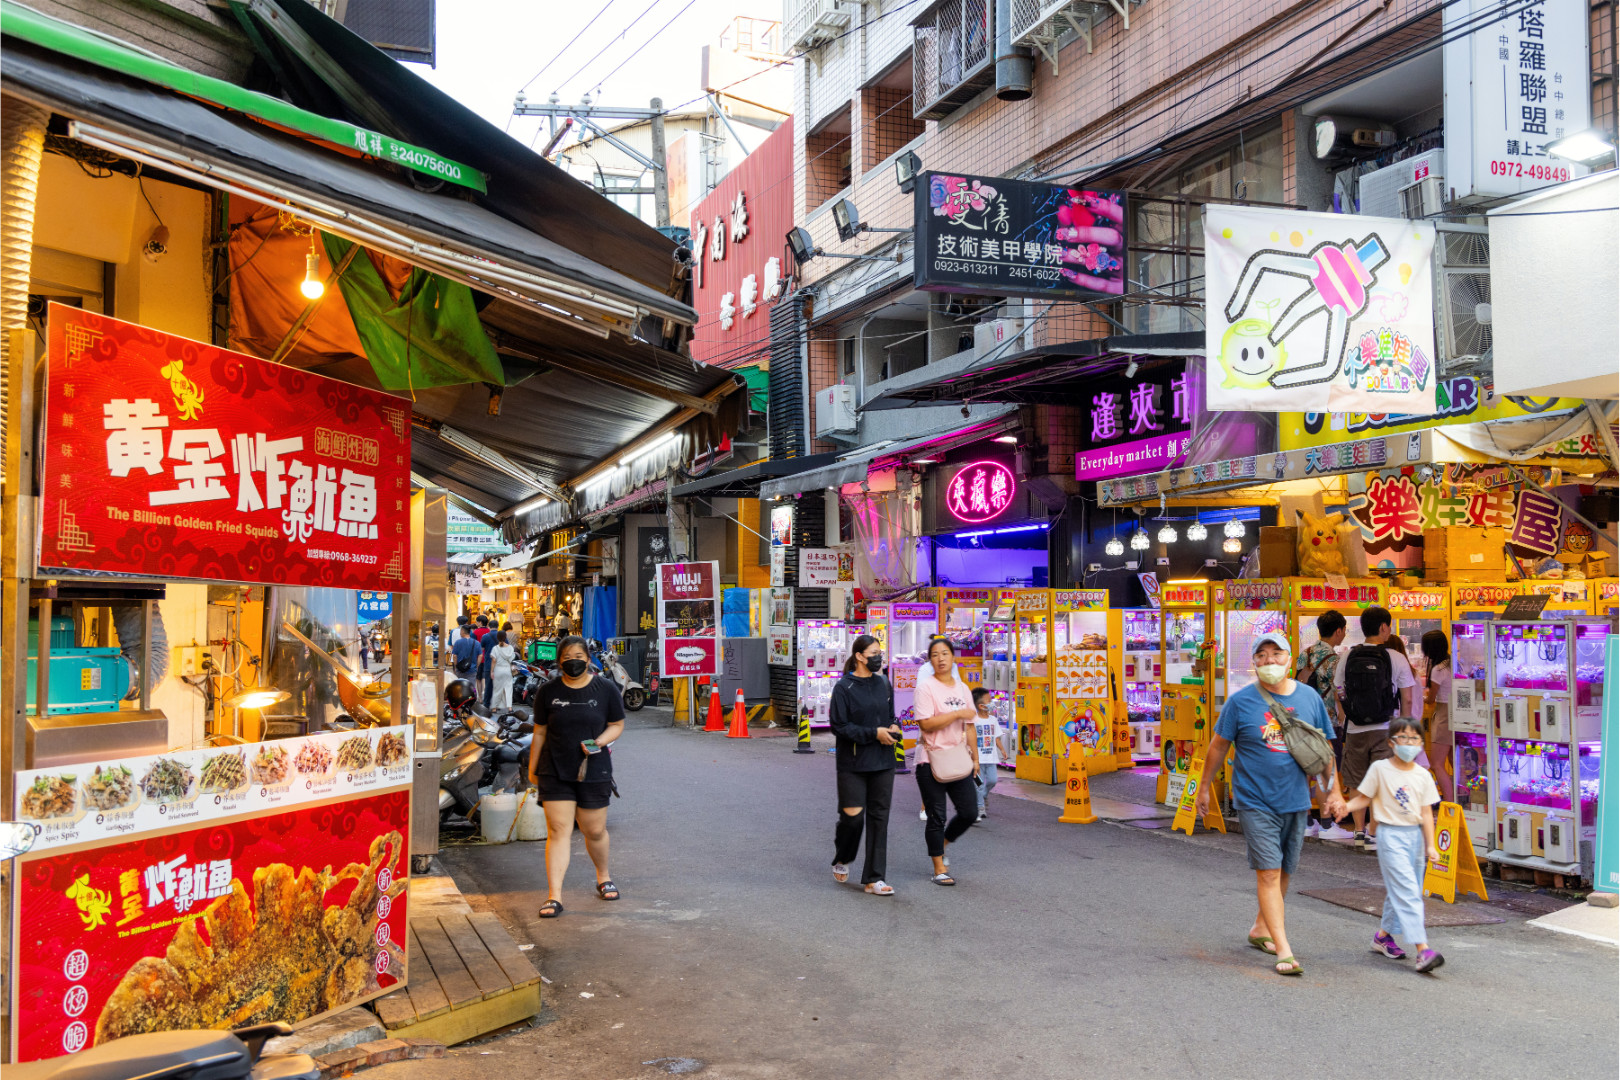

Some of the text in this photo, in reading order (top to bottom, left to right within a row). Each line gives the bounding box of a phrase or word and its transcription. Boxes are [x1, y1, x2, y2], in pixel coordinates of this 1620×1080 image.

[1518, 0, 1548, 136] 塔羅聯盟
[354, 128, 383, 157] 旭祥
[399, 147, 462, 179] 24075600
[1506, 139, 1560, 160] 請上二
[937, 233, 1063, 265] 技術美甲學院
[934, 260, 1061, 281] 0923-613211 2451-6022
[1345, 330, 1429, 383] 大樂娃娃屋
[1366, 375, 1409, 390] DOLLAR
[60, 382, 74, 489] 新鮮味美
[315, 428, 379, 466] 海鮮炸物
[103, 398, 379, 543] 黃金炸魷魚
[1080, 446, 1125, 473] Everyday
[1126, 444, 1163, 462] market
[1192, 455, 1257, 484] 大樂娃娃屋
[1305, 438, 1388, 474] 大樂娃娃屋
[1102, 480, 1159, 502] 大樂娃娃屋
[106, 506, 279, 539] The Billion Golden Fried Squids
[673, 573, 702, 586] MUJI
[1229, 582, 1284, 600] TOY STORY
[1458, 586, 1517, 602] TOY STORY
[1056, 591, 1105, 602] TOY STORY
[1388, 592, 1443, 607] OY STORY
[61, 829, 79, 841] Spicy
[115, 854, 233, 927] 黃金 炸魷魚
[118, 930, 130, 938] The
[131, 925, 151, 935] Billion
[151, 919, 172, 929] Golden
[173, 915, 188, 924] Fried
[376, 868, 392, 974] 新鮮現炸
[64, 949, 89, 1053] 超炫脆
